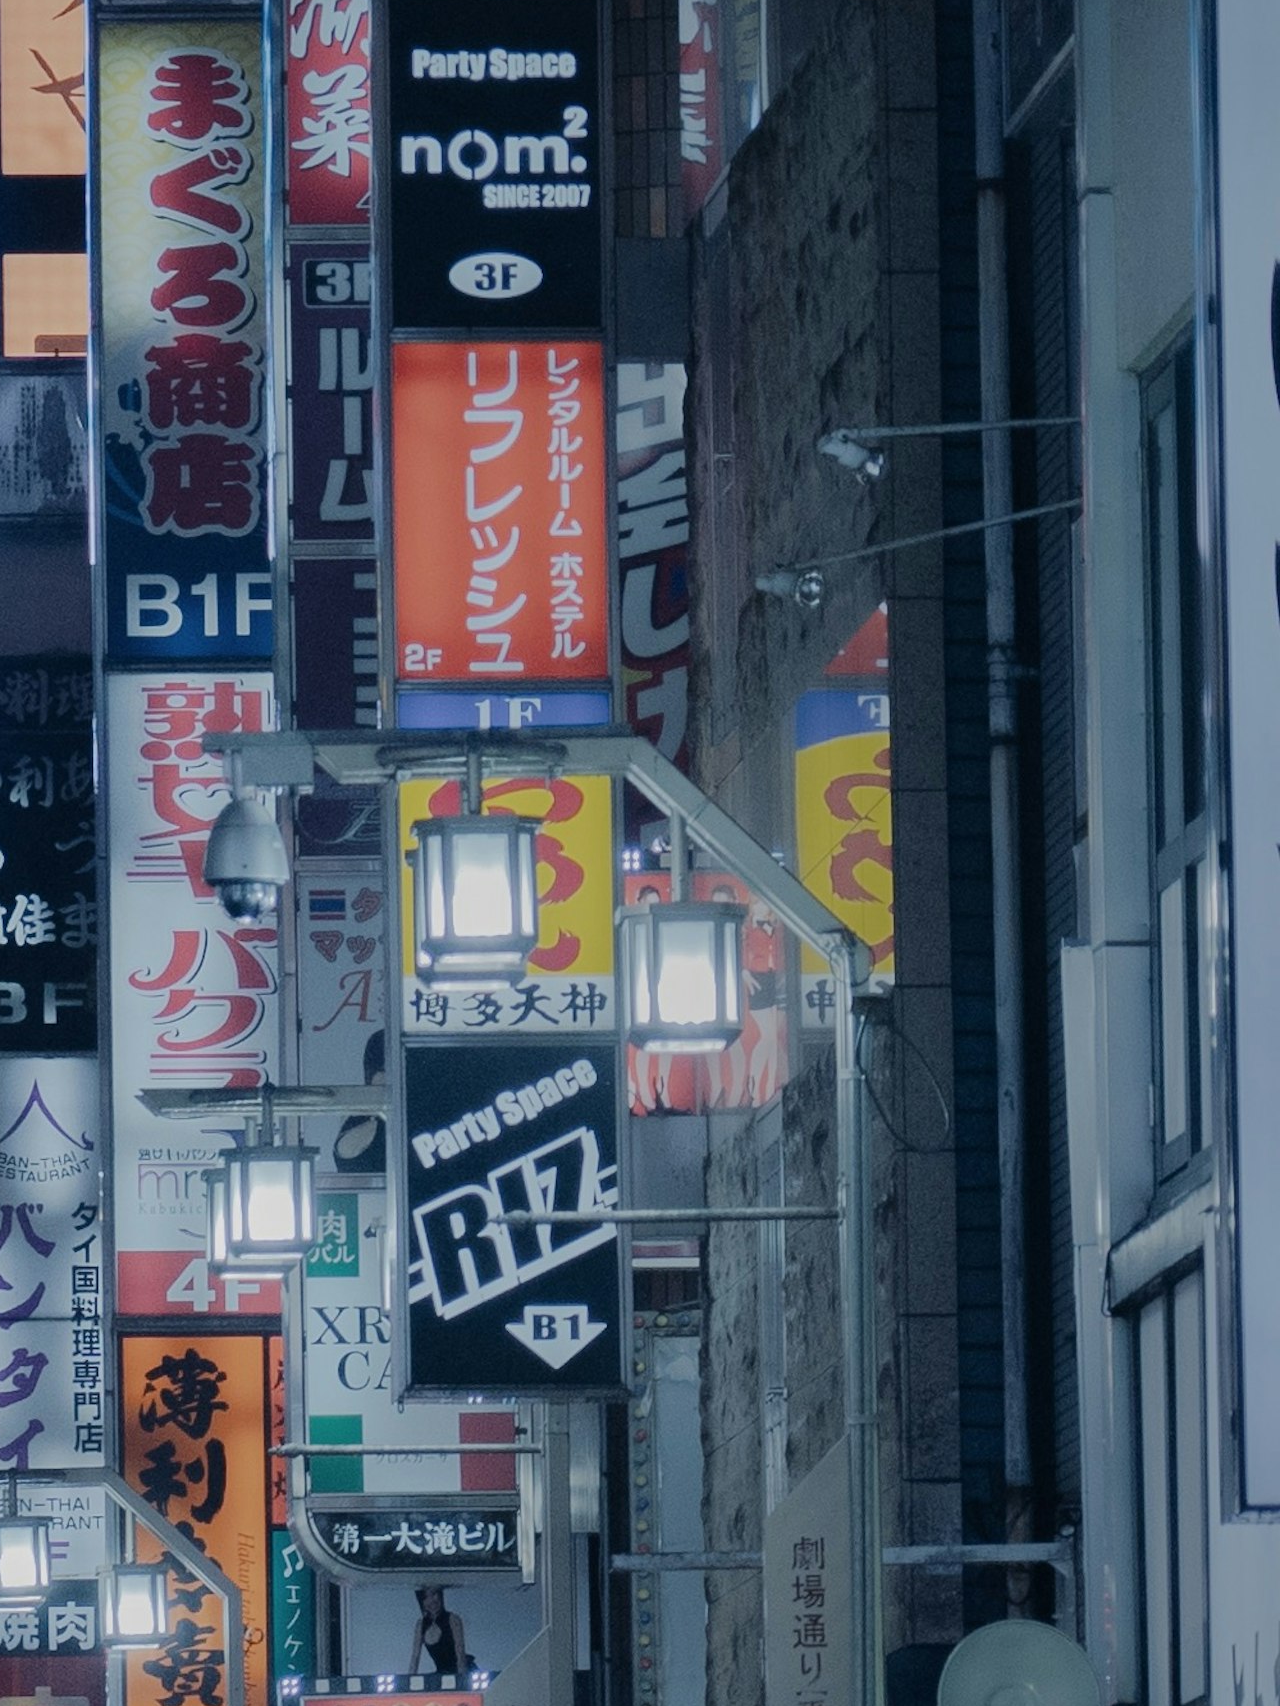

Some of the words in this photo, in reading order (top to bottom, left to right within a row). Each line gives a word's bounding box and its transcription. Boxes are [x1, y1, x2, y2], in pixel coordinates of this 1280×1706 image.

[411, 48, 491, 84] Party
[490, 48, 578, 80] Space
[482, 182, 542, 209] SINCE
[541, 182, 592, 209] 2007
[140, 49, 260, 535] まぐろ商店
[474, 261, 519, 290] 3F
[545, 347, 585, 538] レンタルルーム
[463, 348, 528, 674] リフレッシュ
[125, 573, 273, 638] B1F
[547, 552, 587, 662] ホステル
[404, 642, 443, 672] 2F
[473, 697, 543, 730] 1F
[408, 984, 609, 1029] 博多天神
[411, 1108, 498, 1171] Party
[496, 1056, 599, 1127] Space
[317, 1209, 348, 1243] 肉
[71, 1201, 105, 1456] タイ国料理専門店
[533, 1315, 582, 1343] B1
[329, 1519, 518, 1558] 第一大滝ビル
